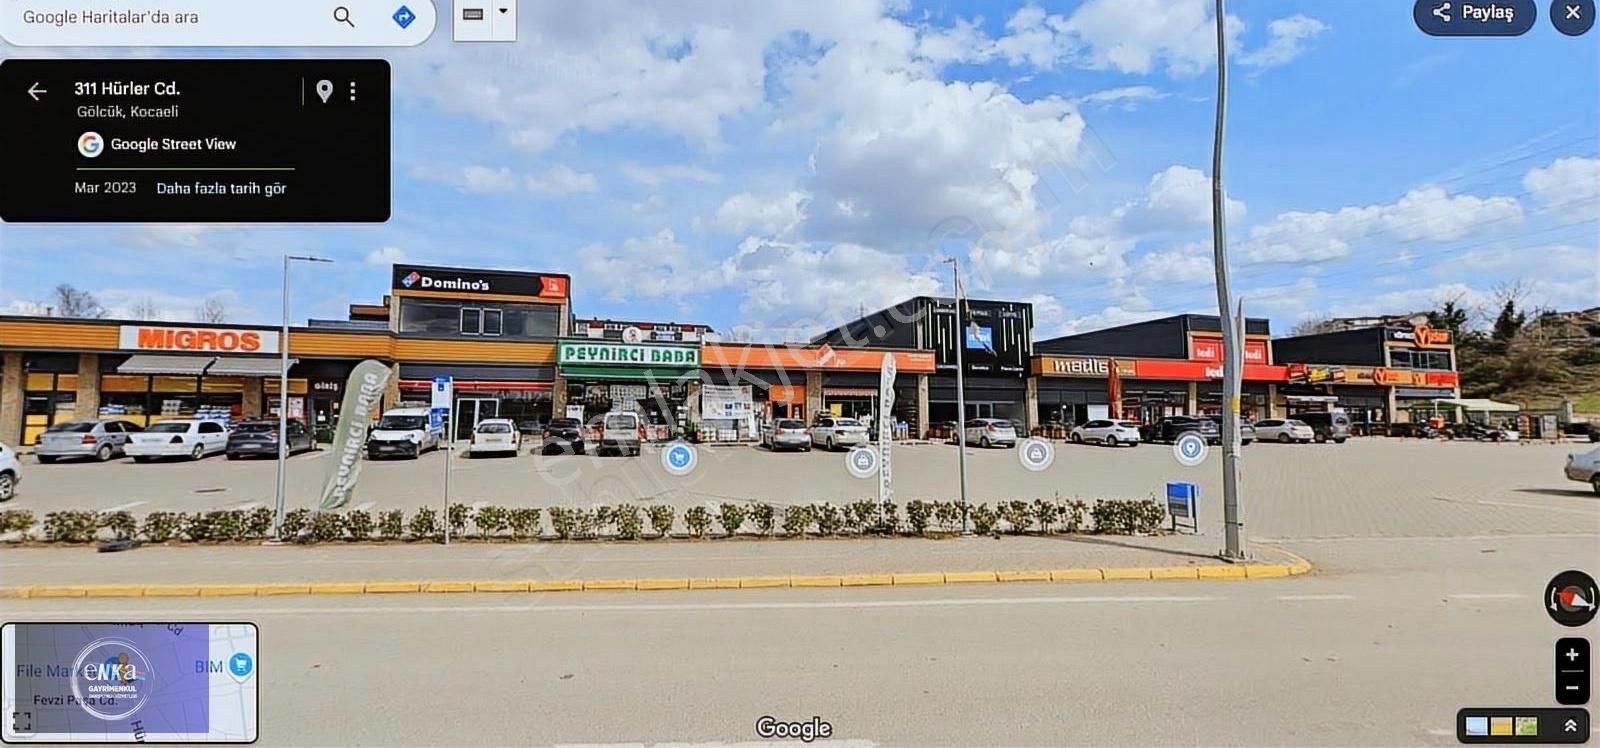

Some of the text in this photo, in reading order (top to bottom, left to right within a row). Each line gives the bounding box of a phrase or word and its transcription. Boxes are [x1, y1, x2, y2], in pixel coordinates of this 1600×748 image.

[421, 276, 490, 291] Domino's
[651, 349, 696, 363] BABA
[1054, 358, 1117, 374] madle
